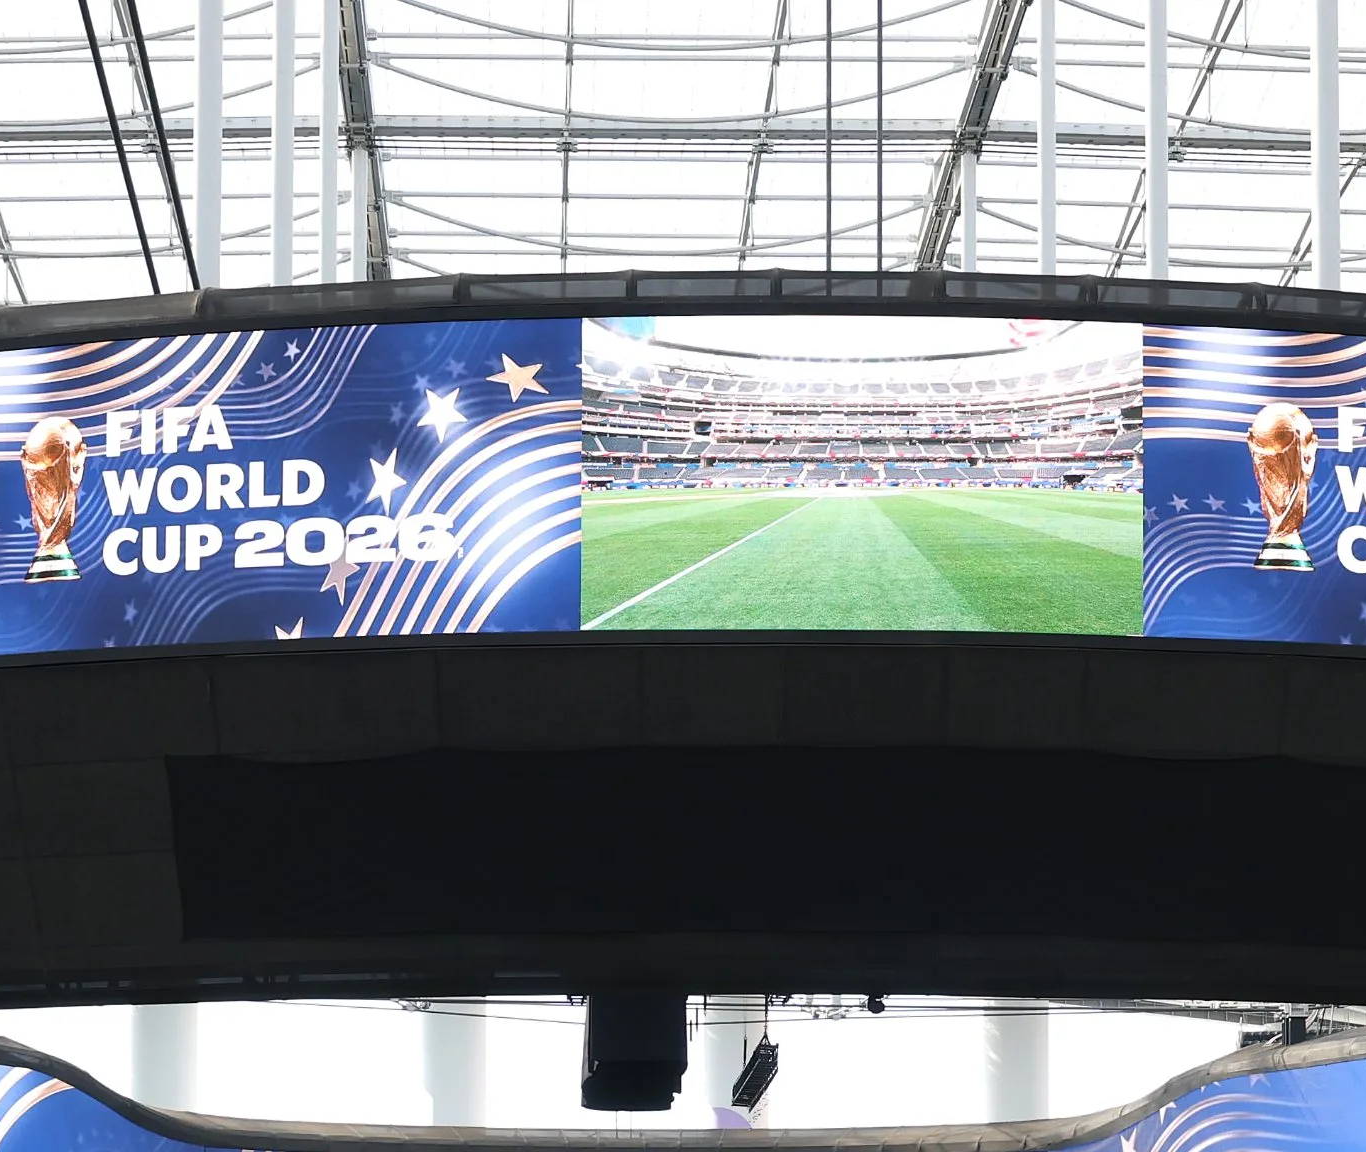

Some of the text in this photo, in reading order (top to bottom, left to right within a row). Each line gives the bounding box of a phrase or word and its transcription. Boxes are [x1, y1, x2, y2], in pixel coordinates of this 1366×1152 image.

[105, 404, 233, 457] FIFA
[104, 459, 325, 516] WORLD
[102, 513, 456, 576] CUP 2026
